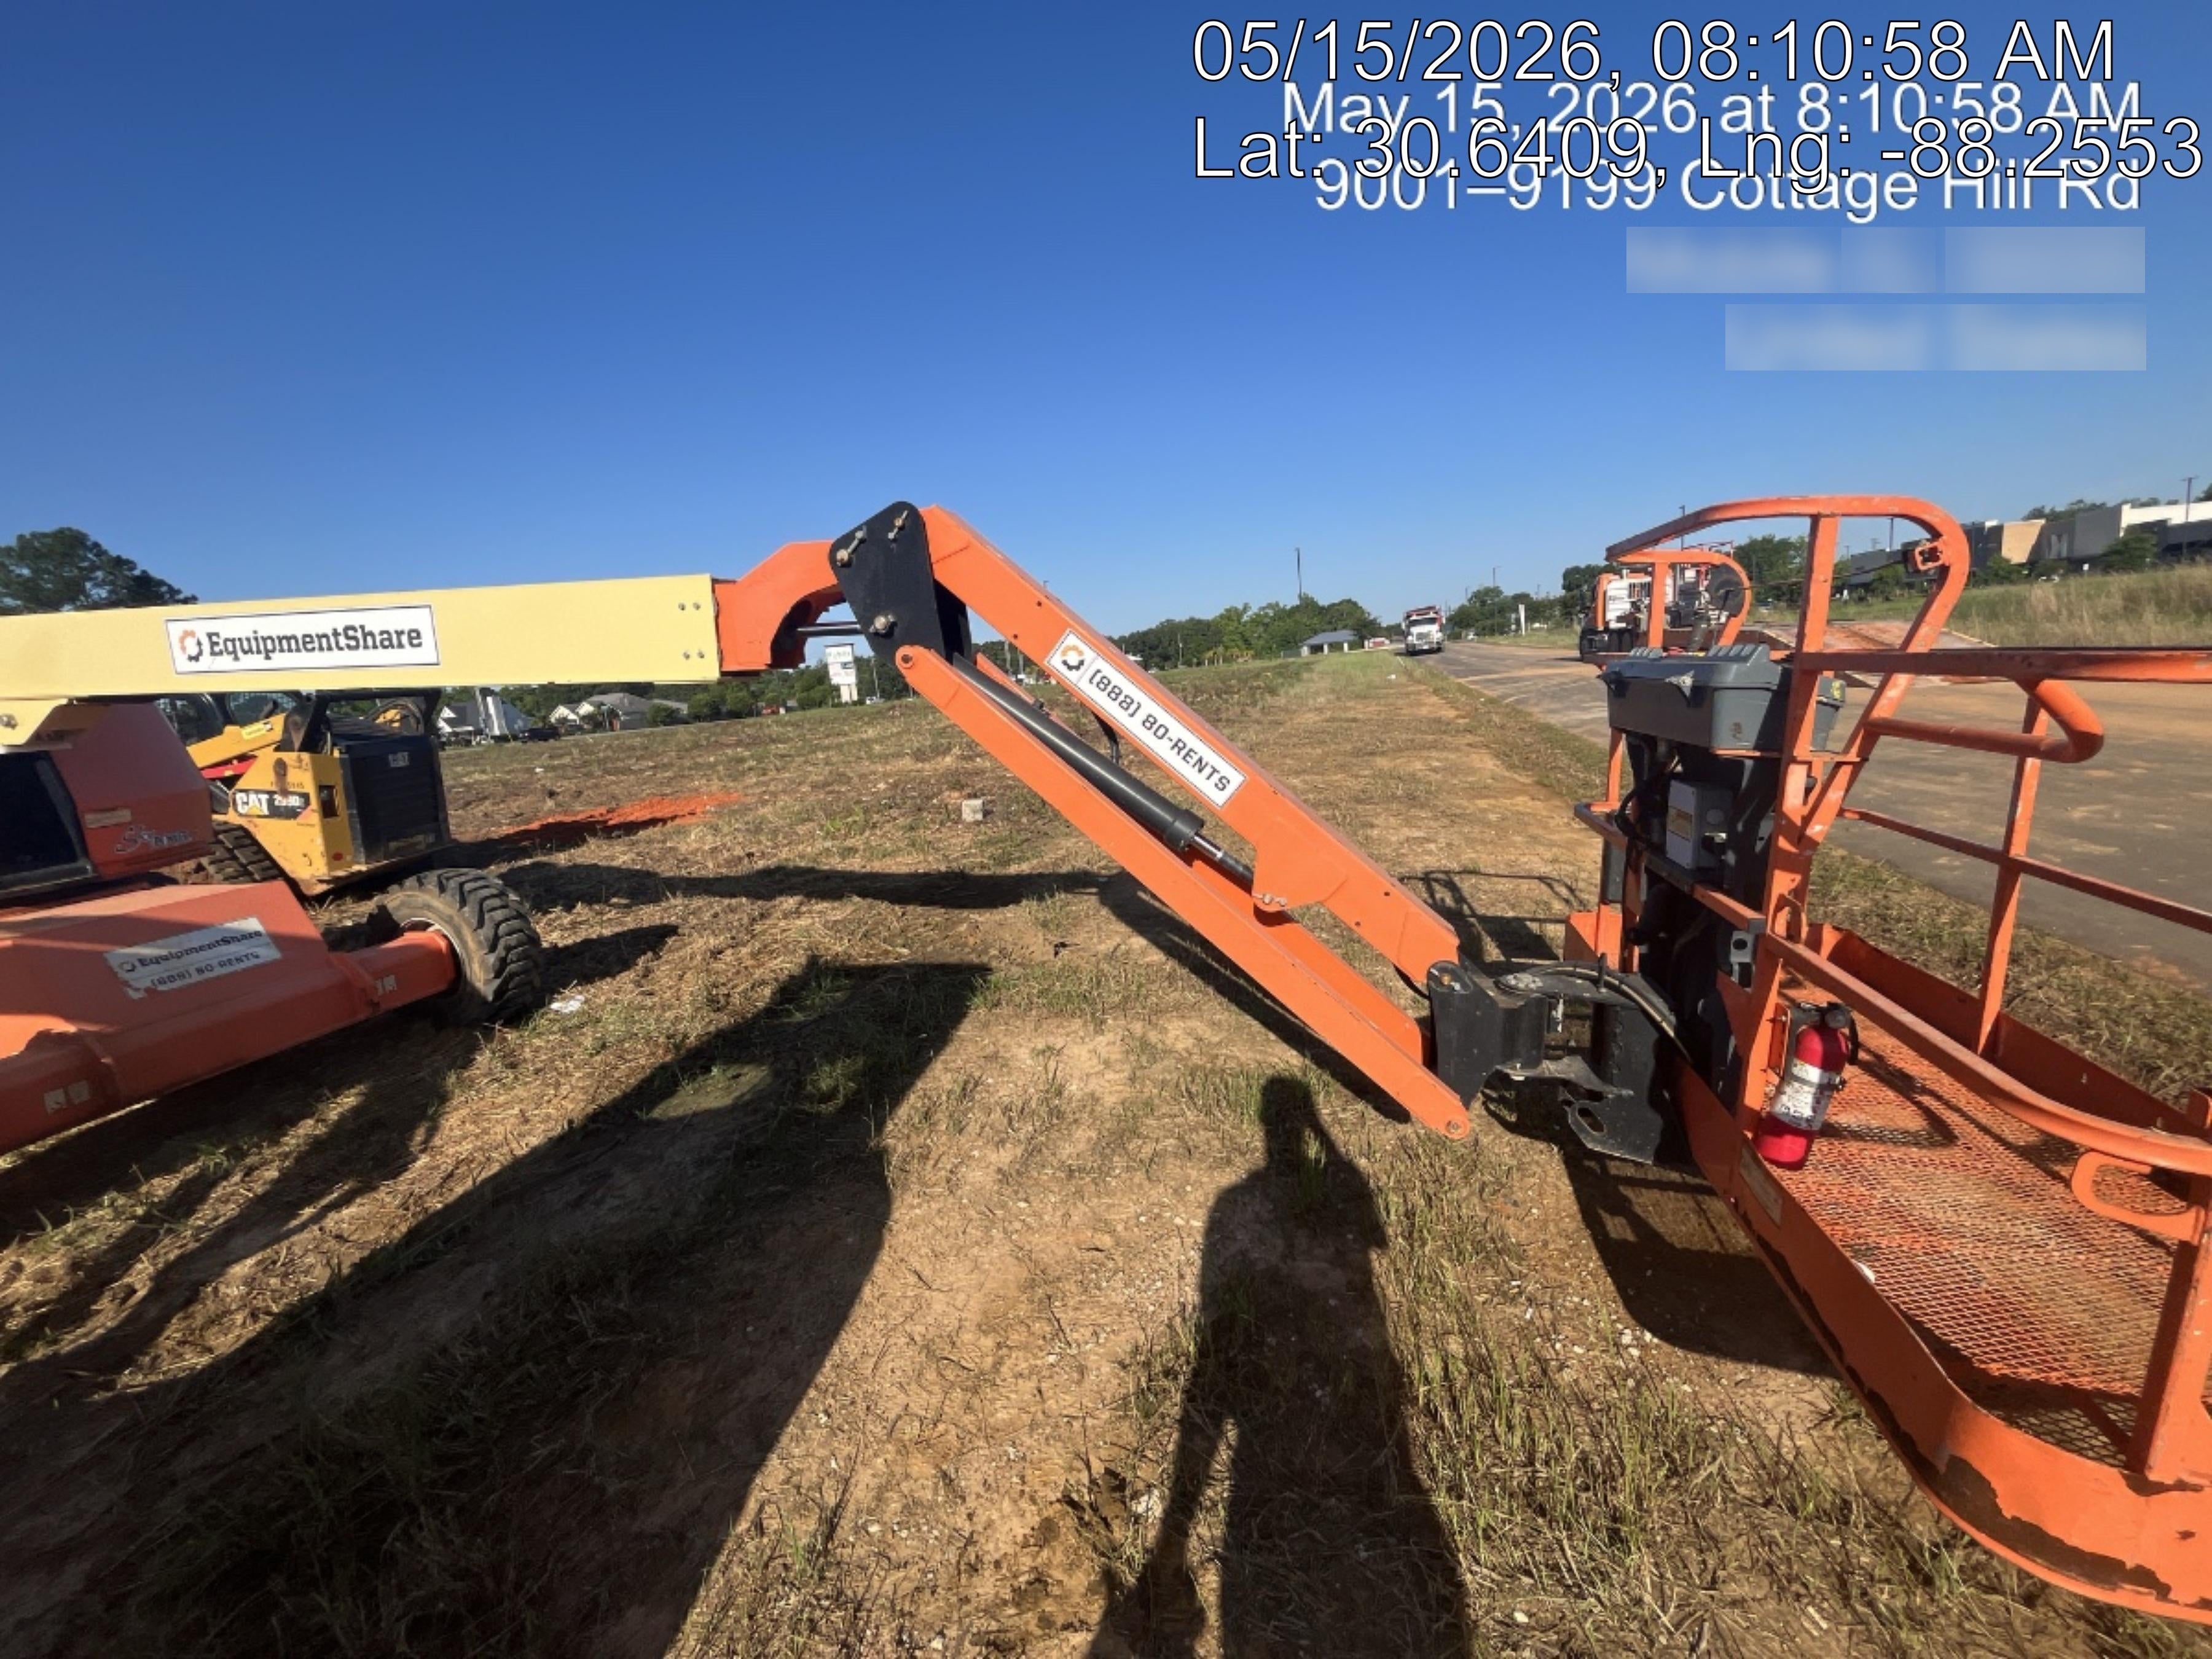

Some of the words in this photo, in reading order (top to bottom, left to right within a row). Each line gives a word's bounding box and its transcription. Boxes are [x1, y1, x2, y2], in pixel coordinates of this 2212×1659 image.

[206, 624, 423, 662] EquipmentShare
[1089, 669, 1141, 718] (888)
[1142, 714, 1231, 792] 80-RENTS
[235, 793, 269, 815] CAT
[137, 930, 262, 967] EquipmentShare
